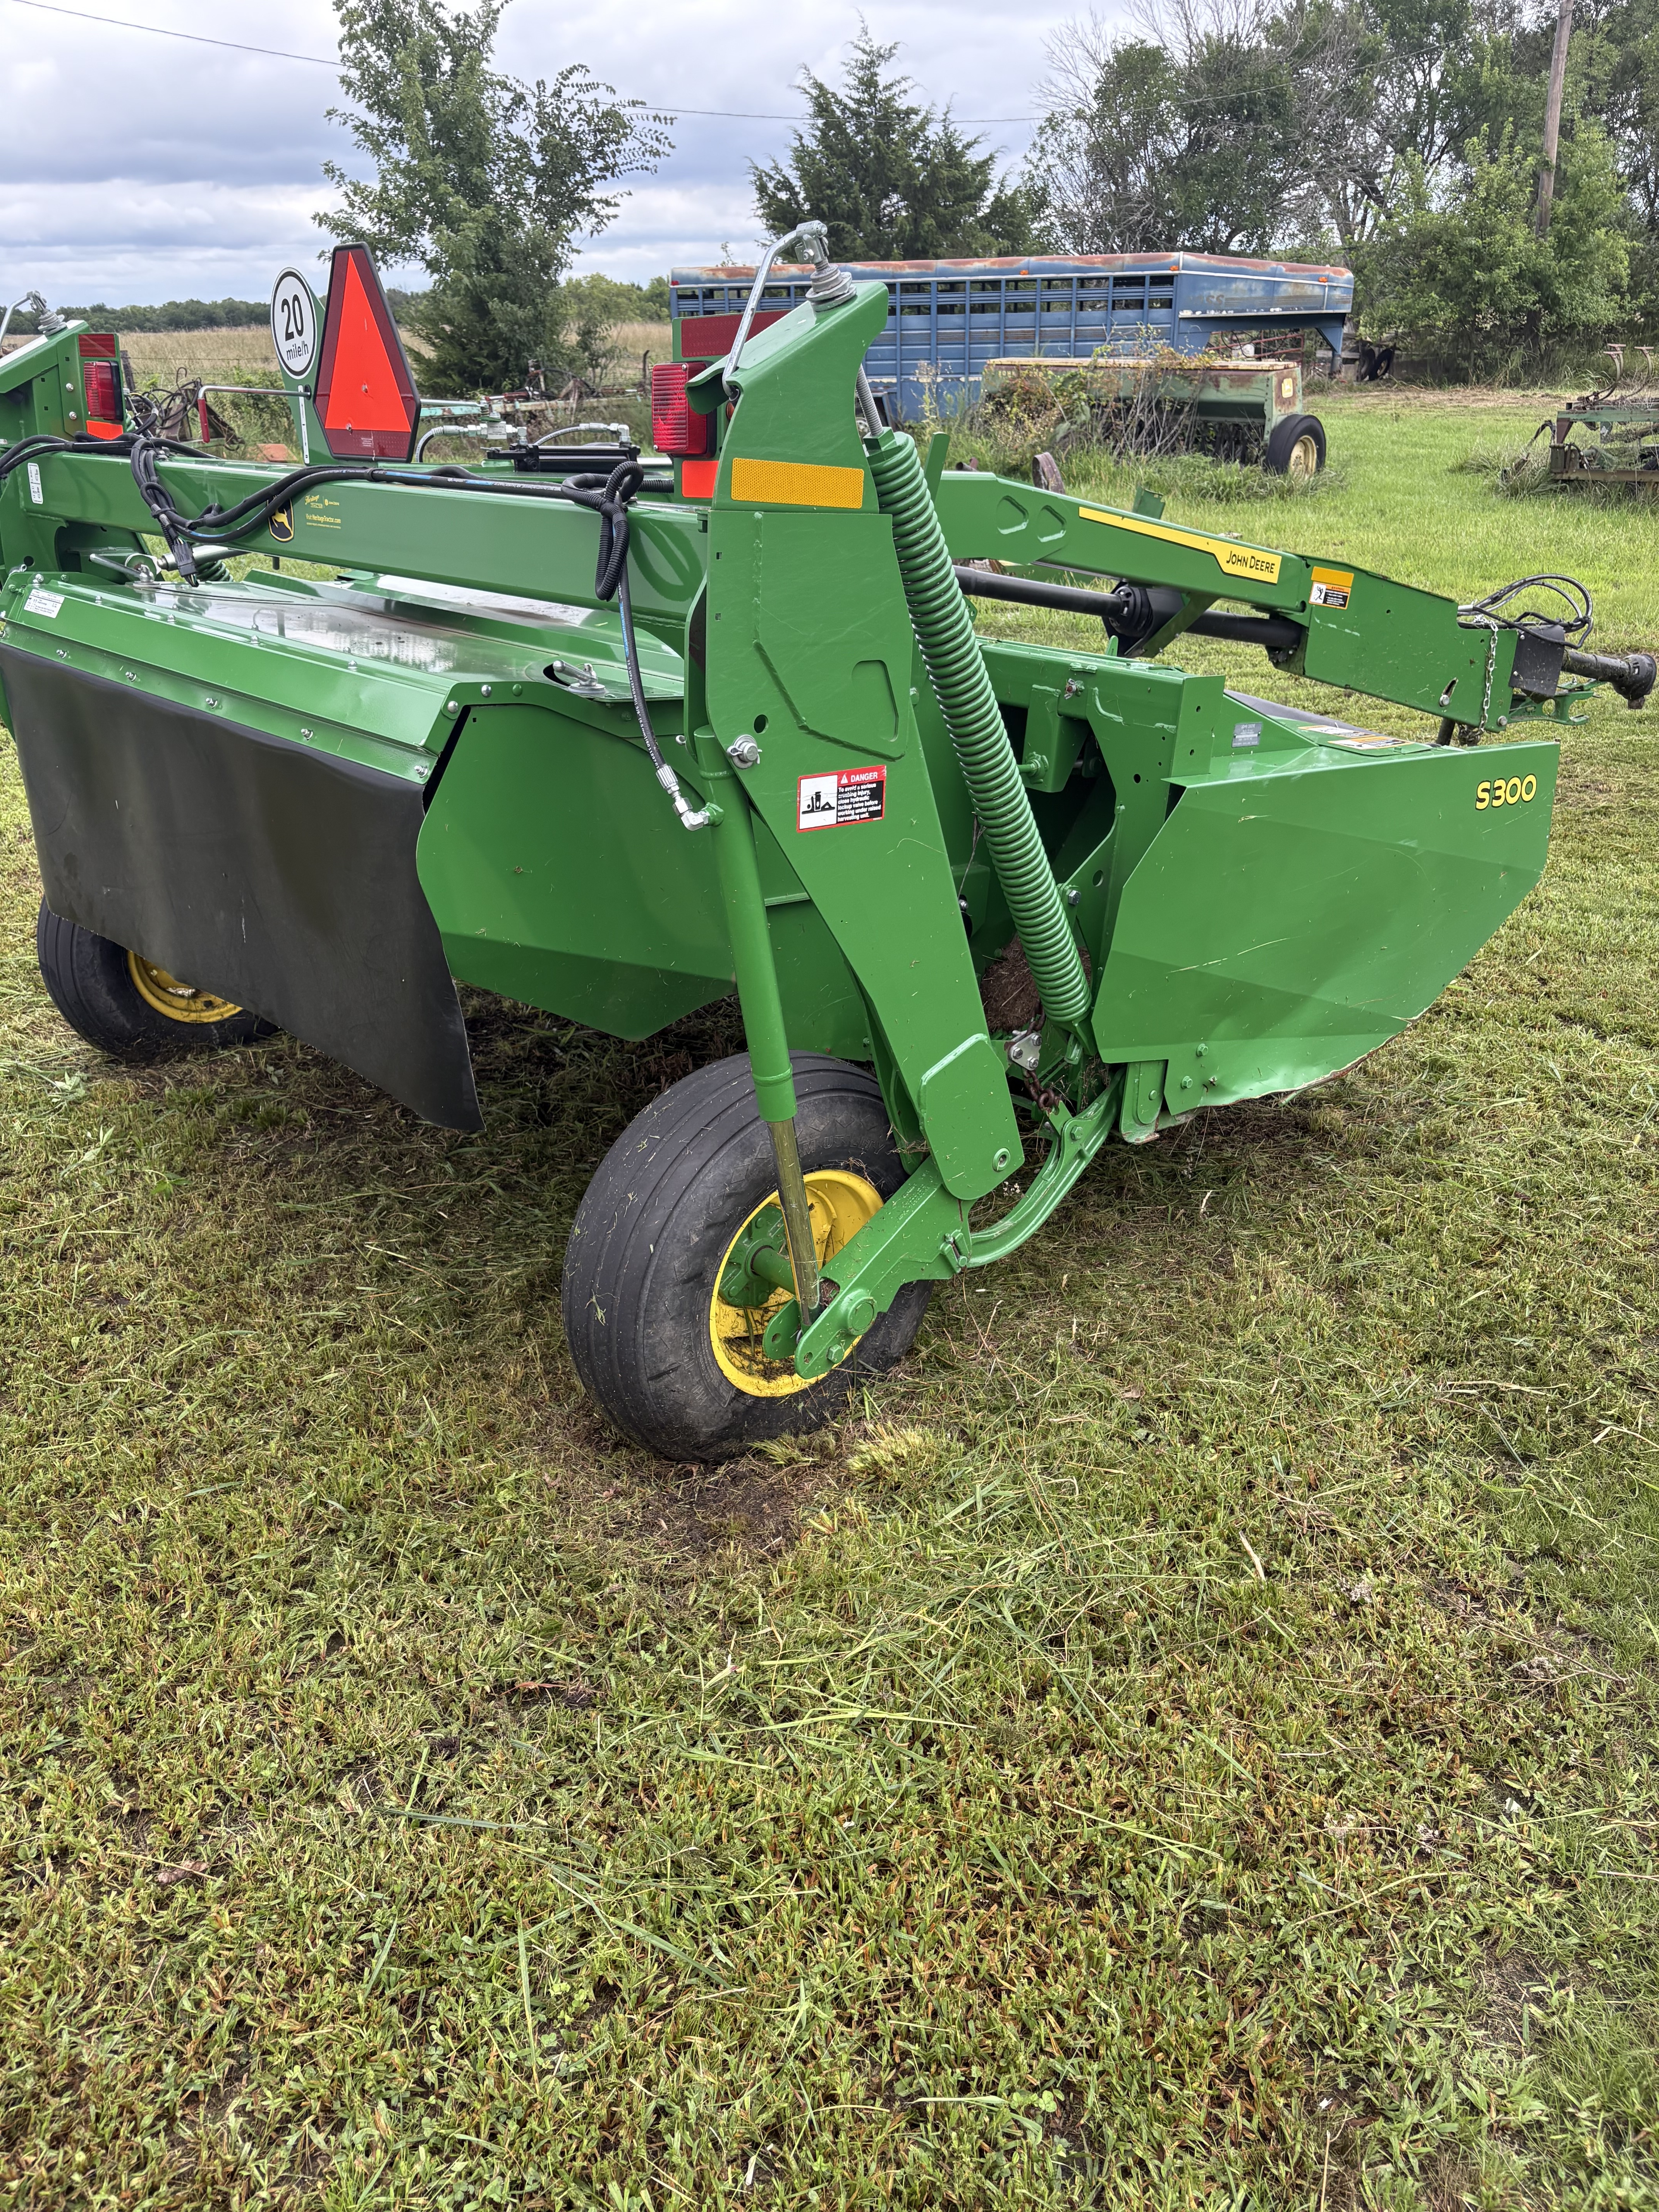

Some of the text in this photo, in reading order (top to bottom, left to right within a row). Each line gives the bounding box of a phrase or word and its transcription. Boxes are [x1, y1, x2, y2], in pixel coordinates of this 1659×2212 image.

[281, 294, 304, 341] 20
[287, 341, 309, 361] mile/h
[1226, 551, 1275, 574] JOHN DEERE
[851, 772, 878, 783] DANGER
[1475, 773, 1537, 811] S300
